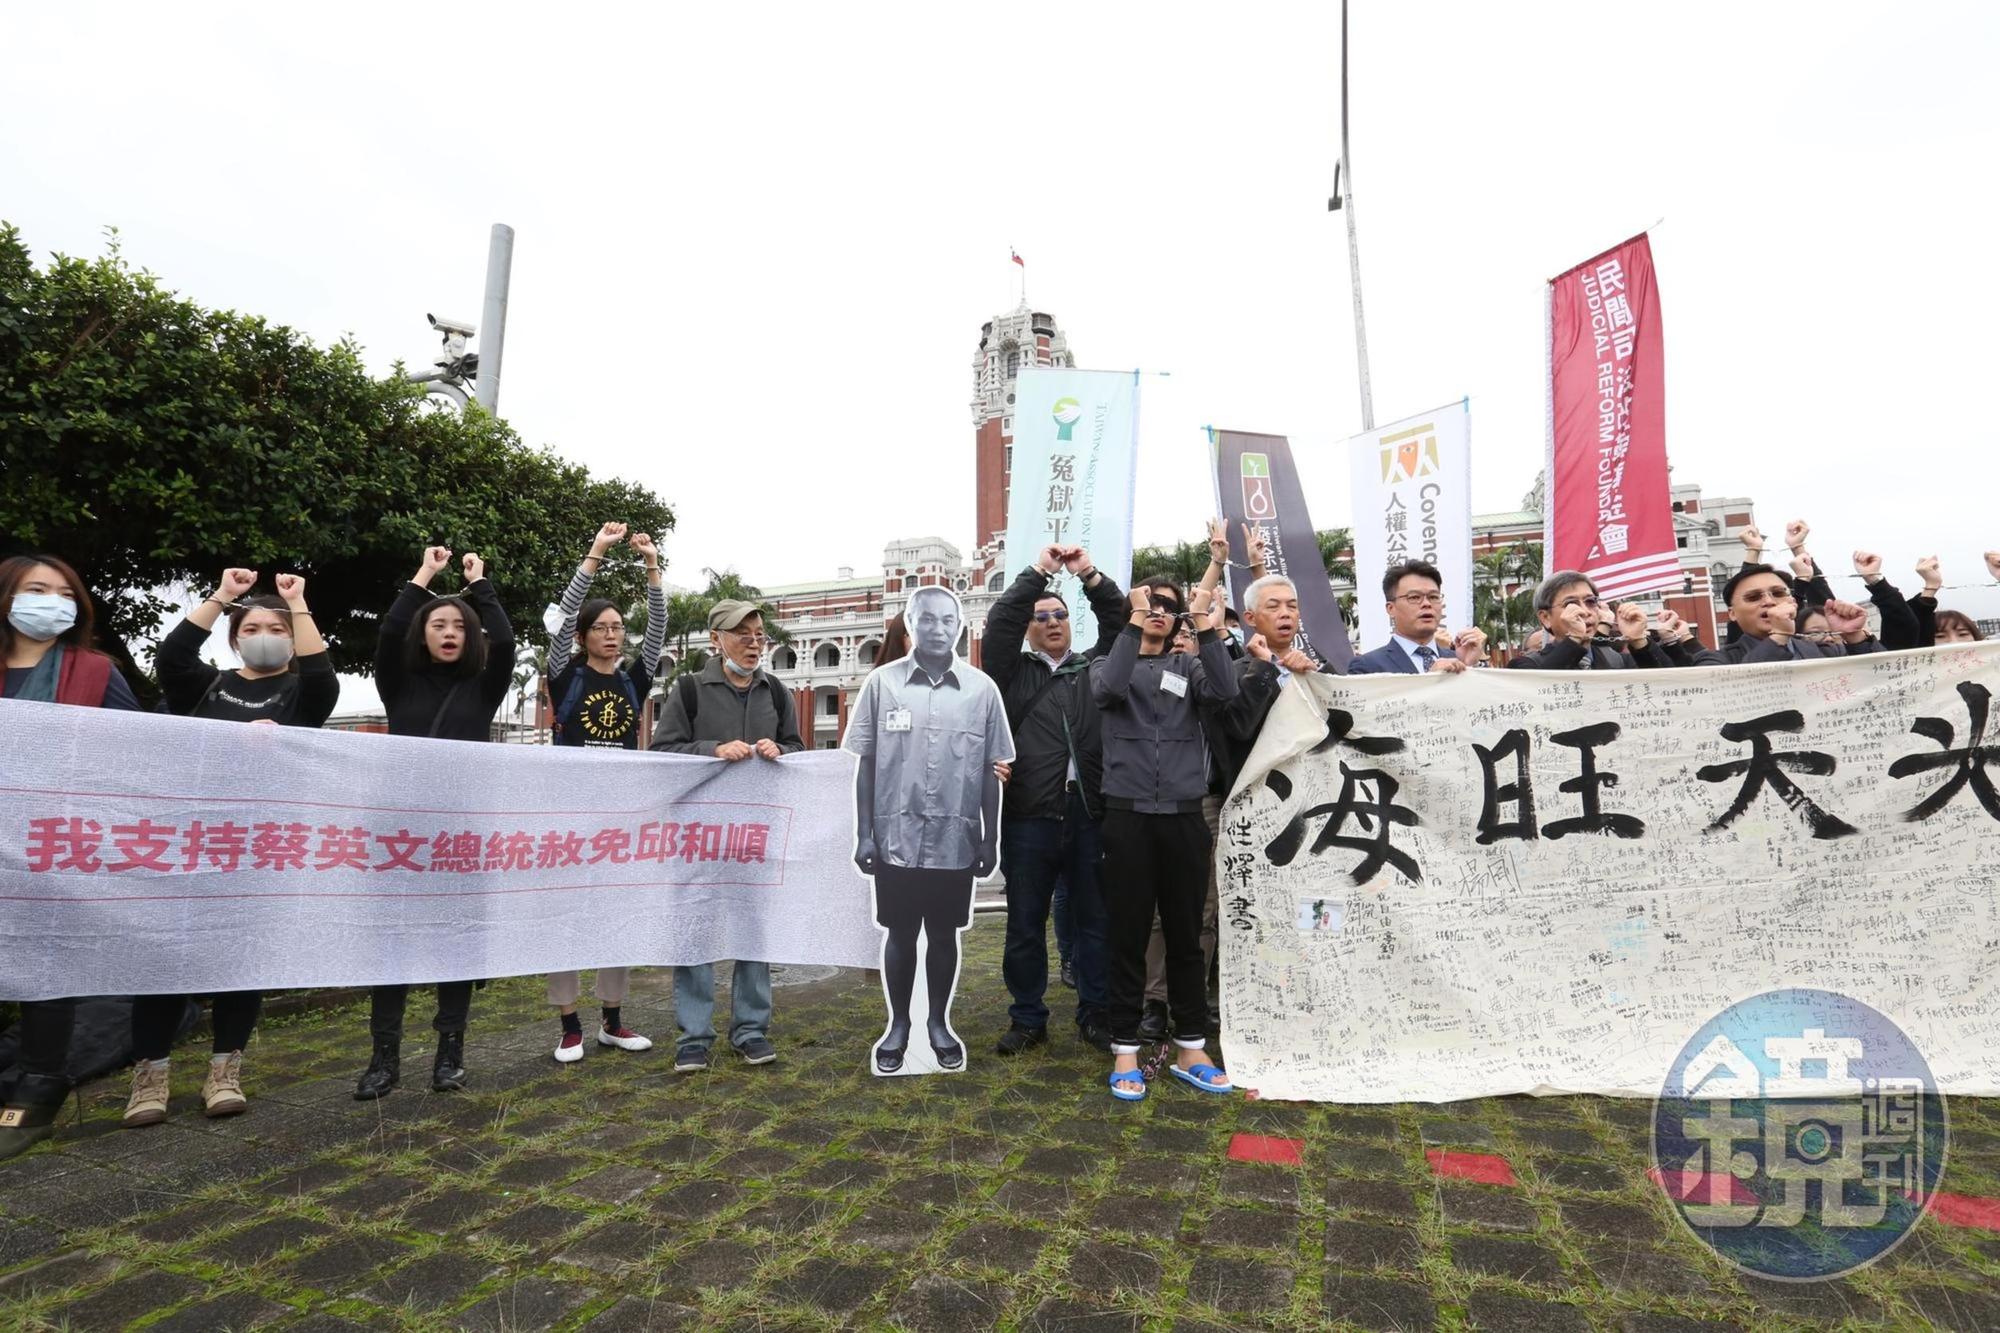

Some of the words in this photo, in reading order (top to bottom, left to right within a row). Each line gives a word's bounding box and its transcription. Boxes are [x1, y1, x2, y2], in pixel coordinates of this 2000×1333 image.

[1581, 273, 1610, 359] JUDICIAL
[1597, 361, 1616, 444] REFORM
[1091, 401, 1108, 452] TAIWAN
[1080, 453, 1100, 536] ASSOCIATION
[1272, 525, 1283, 556] Taiwan
[580, 704, 633, 738] INTERNATIONAL
[584, 690, 625, 706] AMNESTY
[26, 817, 770, 873] 我支持蔡英文總統赦免邱和順
